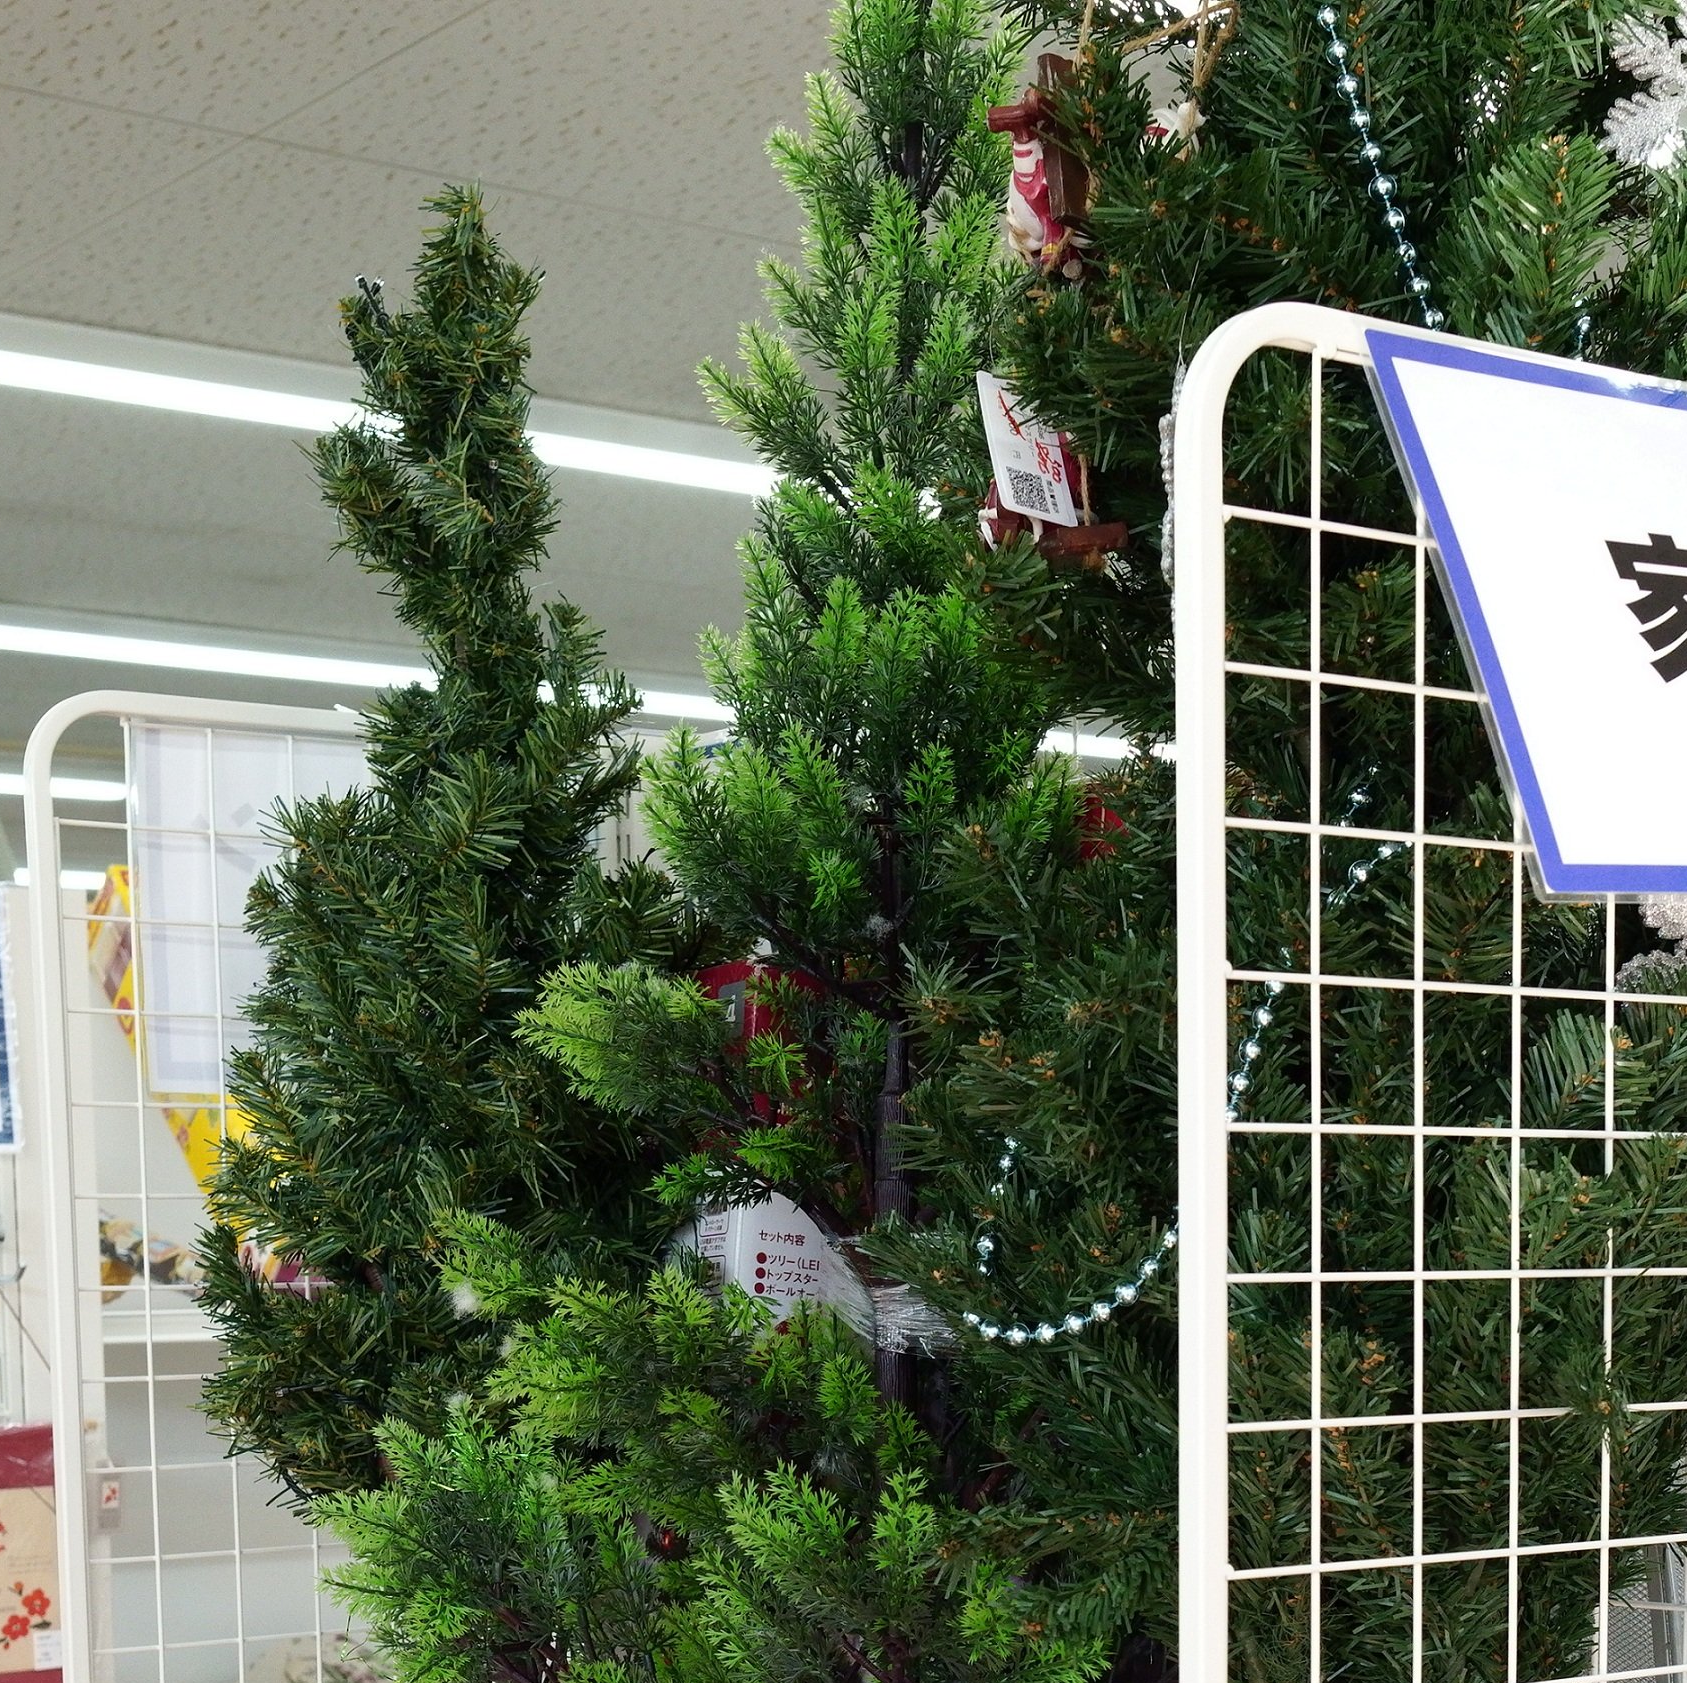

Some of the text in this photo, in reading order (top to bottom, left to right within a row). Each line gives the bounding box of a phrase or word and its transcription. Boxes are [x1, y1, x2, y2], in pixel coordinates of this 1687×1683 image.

[759, 1231, 806, 1247] セット内容
